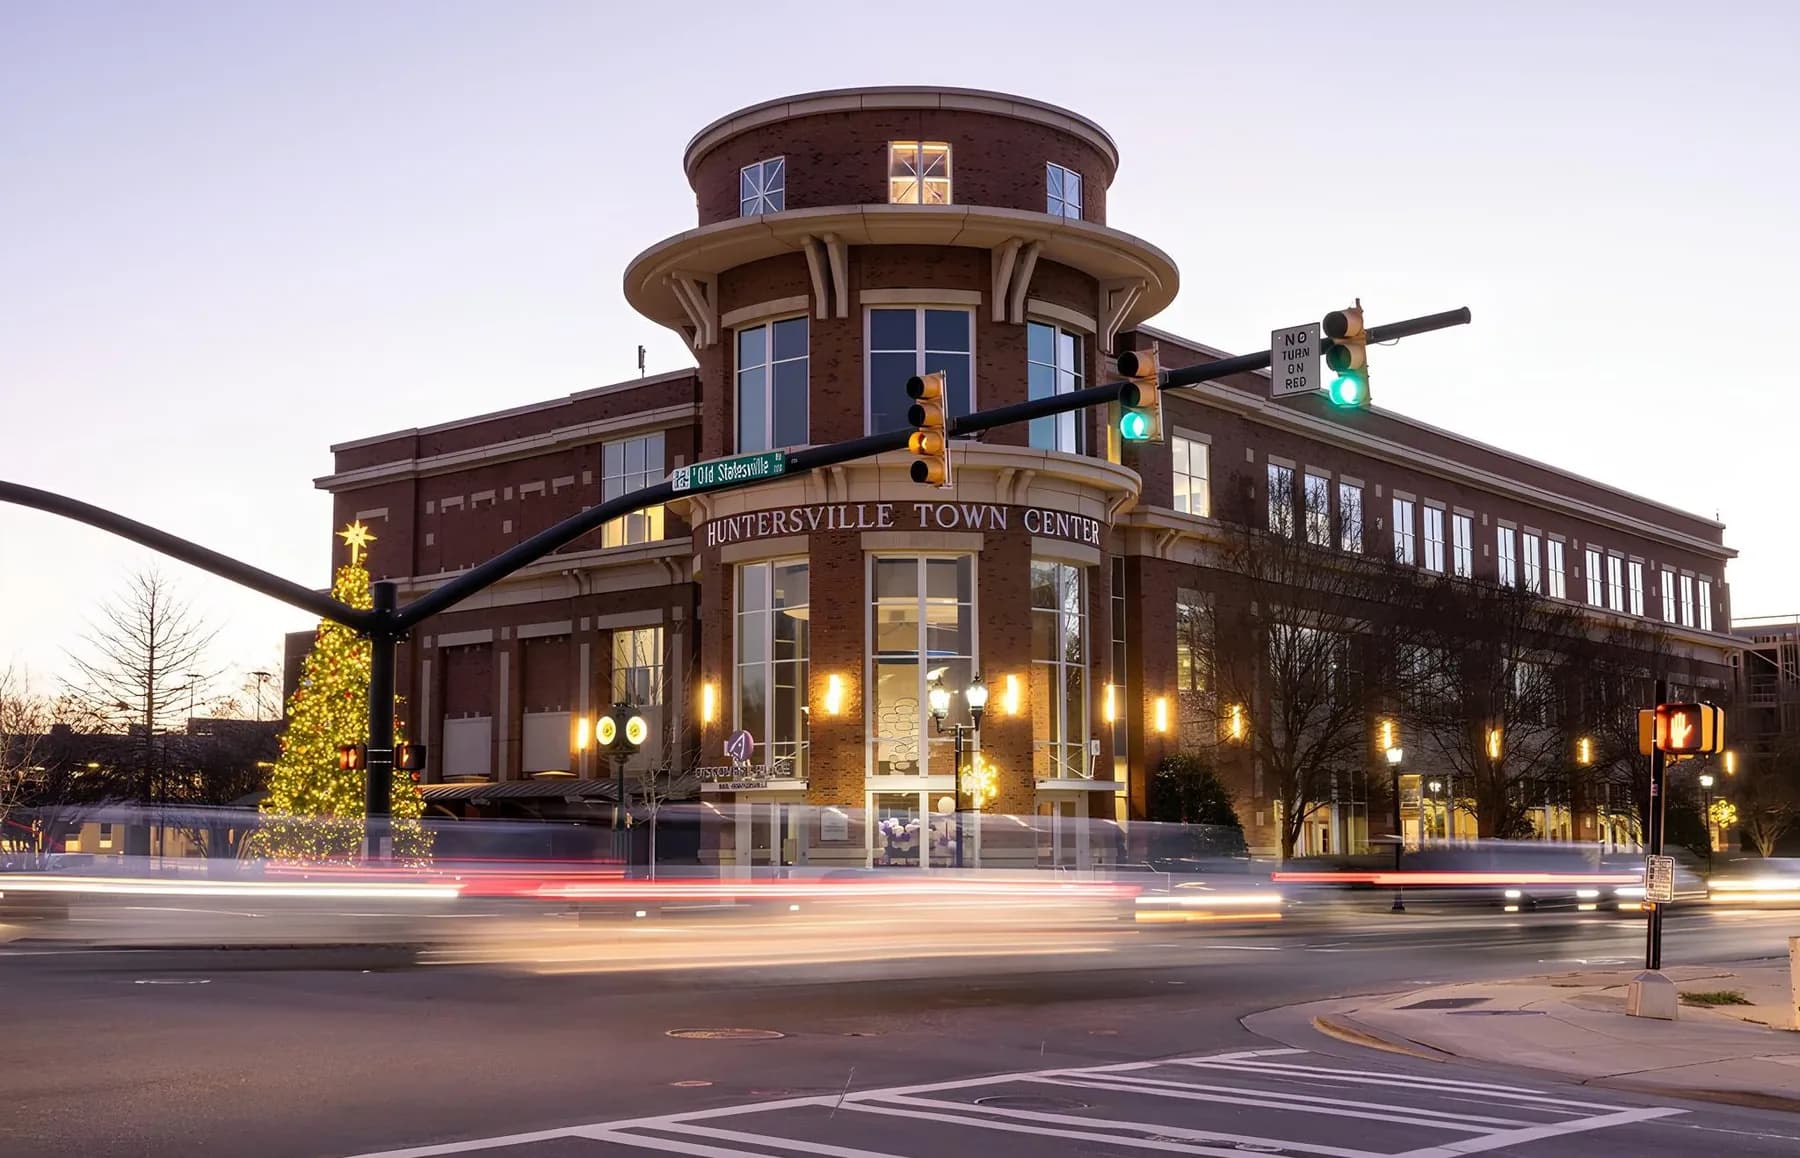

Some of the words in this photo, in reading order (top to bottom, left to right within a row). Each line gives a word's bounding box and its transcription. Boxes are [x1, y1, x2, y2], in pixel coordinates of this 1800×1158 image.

[1285, 331, 1307, 346] NO
[1282, 347, 1310, 360] TURN
[1288, 362, 1304, 374] ON
[1285, 376, 1307, 389] RED
[697, 465, 714, 485] Old
[718, 457, 769, 482] Statesville
[707, 503, 895, 547] HUNTERSVILLE
[913, 503, 1008, 530] TOWN
[1024, 508, 1100, 545] CENTER
